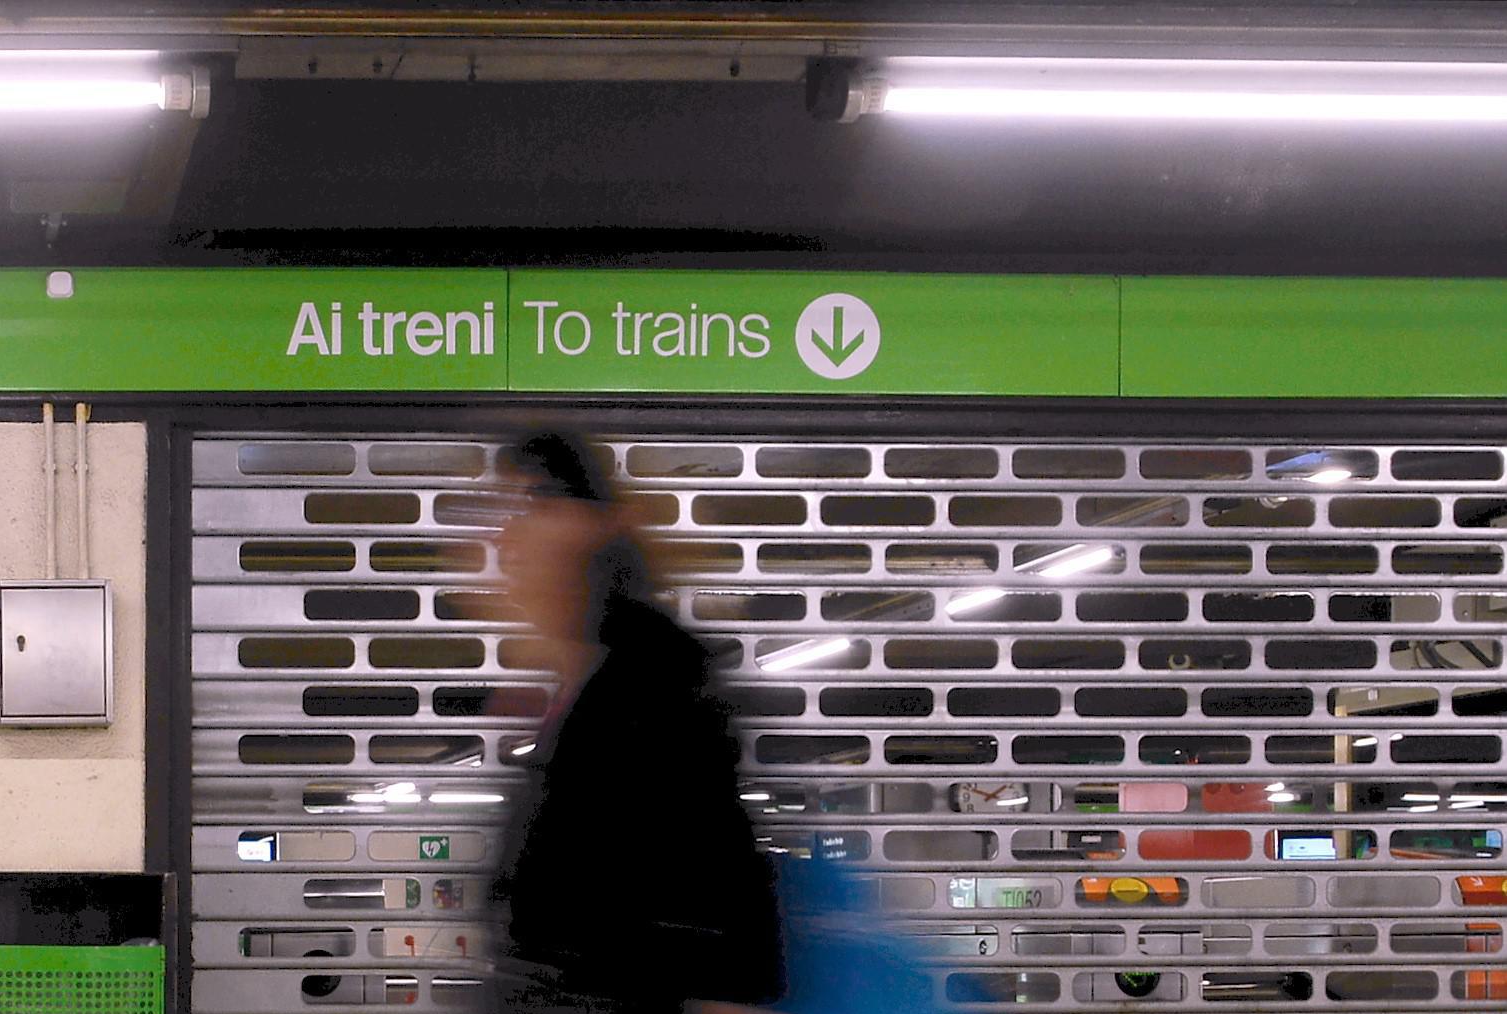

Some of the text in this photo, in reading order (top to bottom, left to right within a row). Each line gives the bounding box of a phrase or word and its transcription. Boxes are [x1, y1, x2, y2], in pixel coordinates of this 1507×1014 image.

[286, 300, 771, 359] Ai treni To trains
